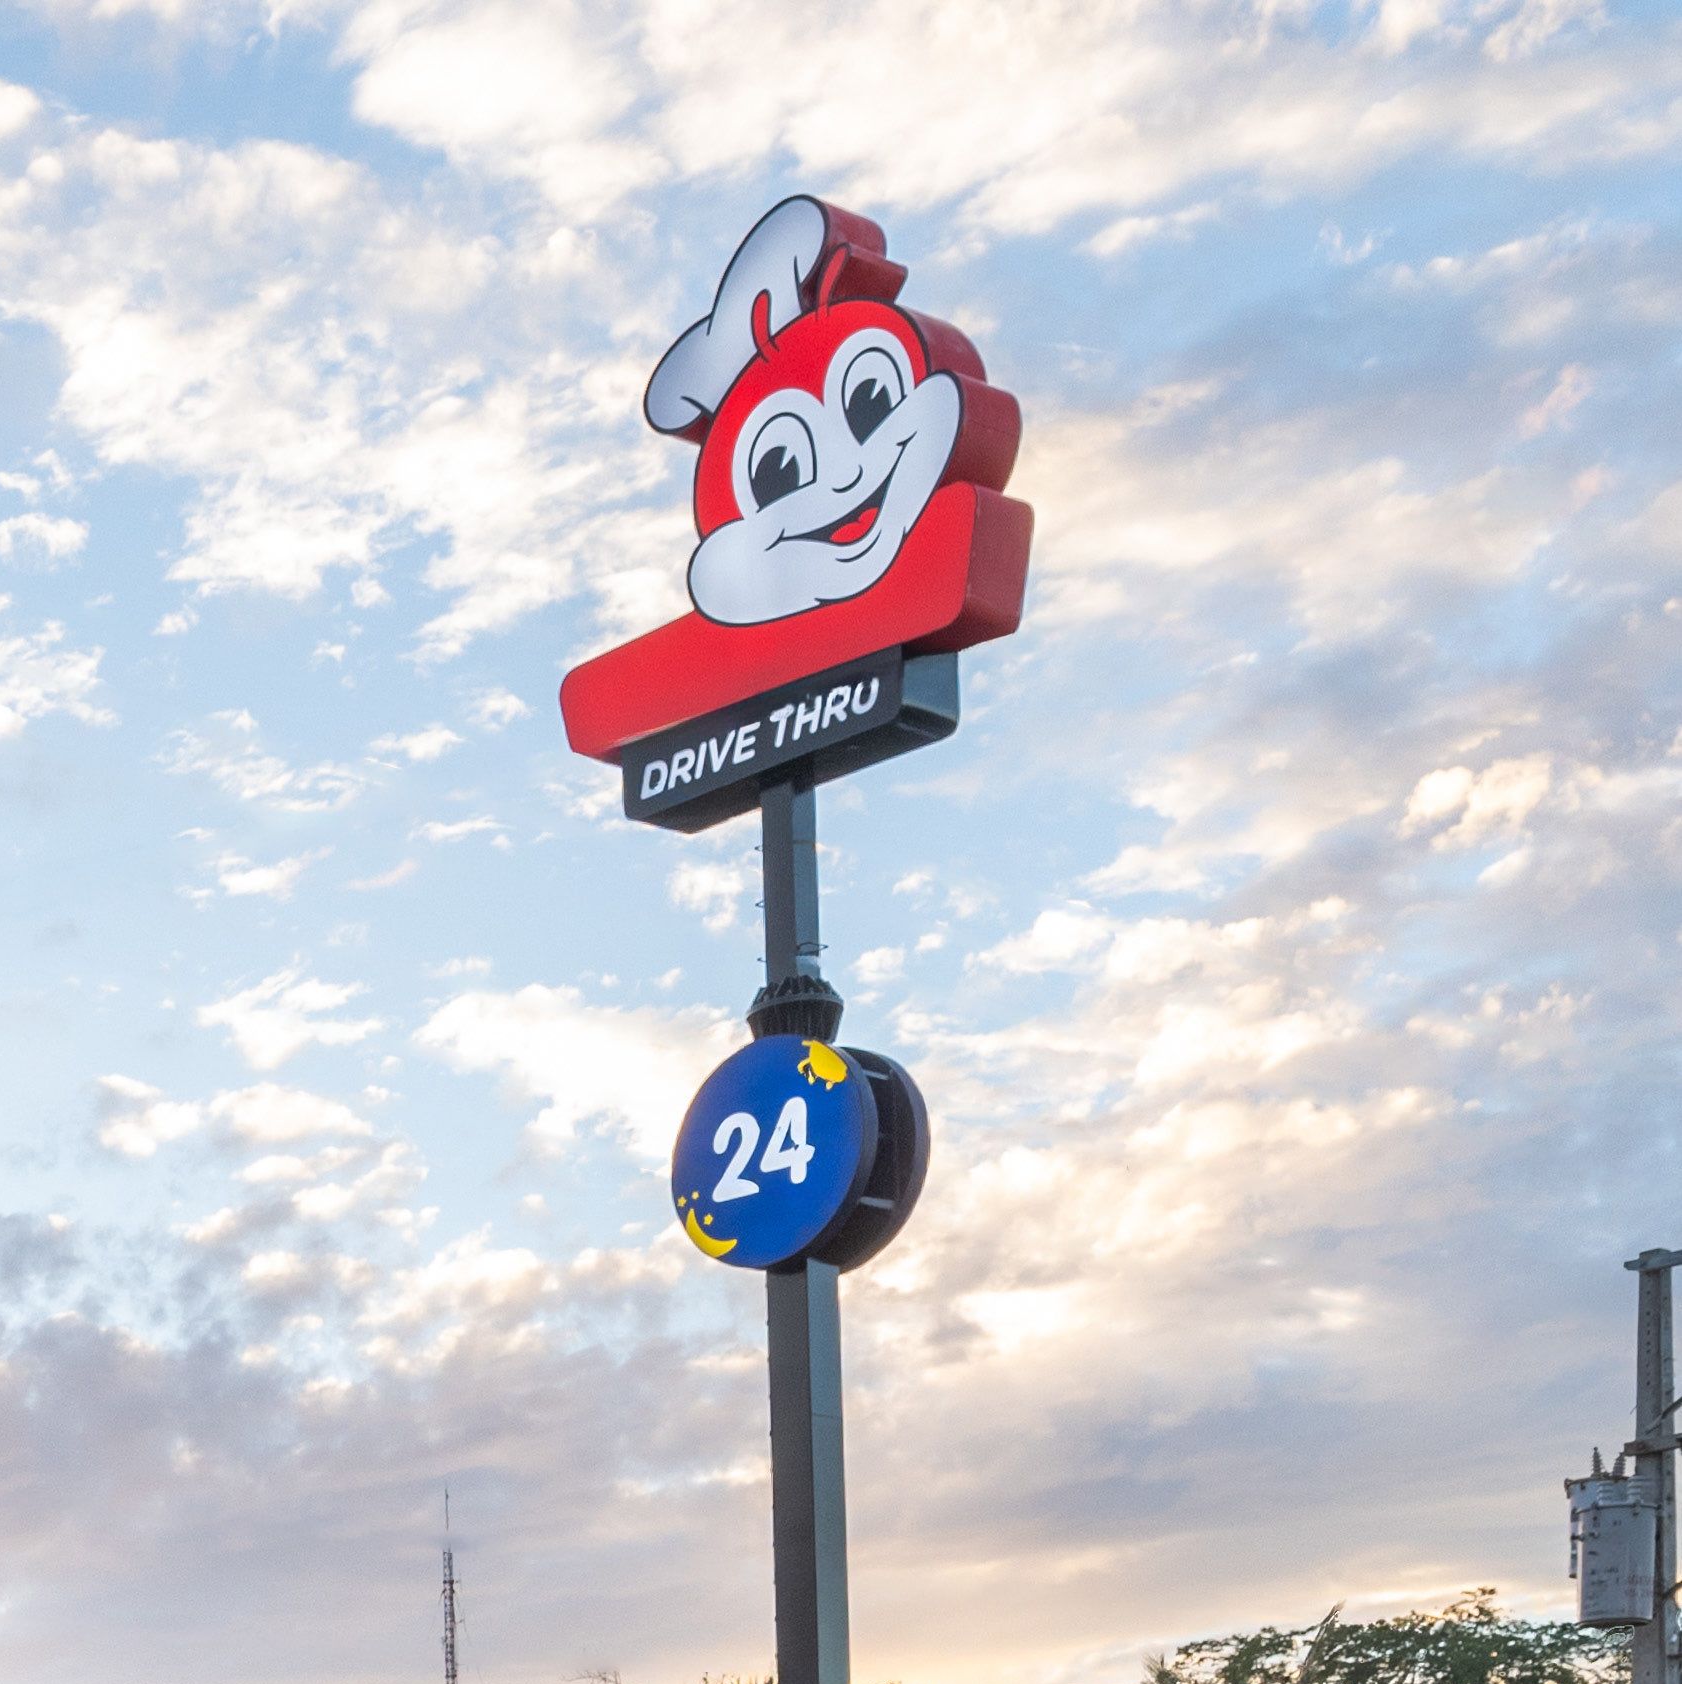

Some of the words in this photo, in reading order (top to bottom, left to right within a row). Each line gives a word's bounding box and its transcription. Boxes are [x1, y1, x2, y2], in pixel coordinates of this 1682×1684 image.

[640, 721, 761, 800] DRIVE
[769, 677, 880, 748] THRU
[712, 1096, 815, 1203] 24
